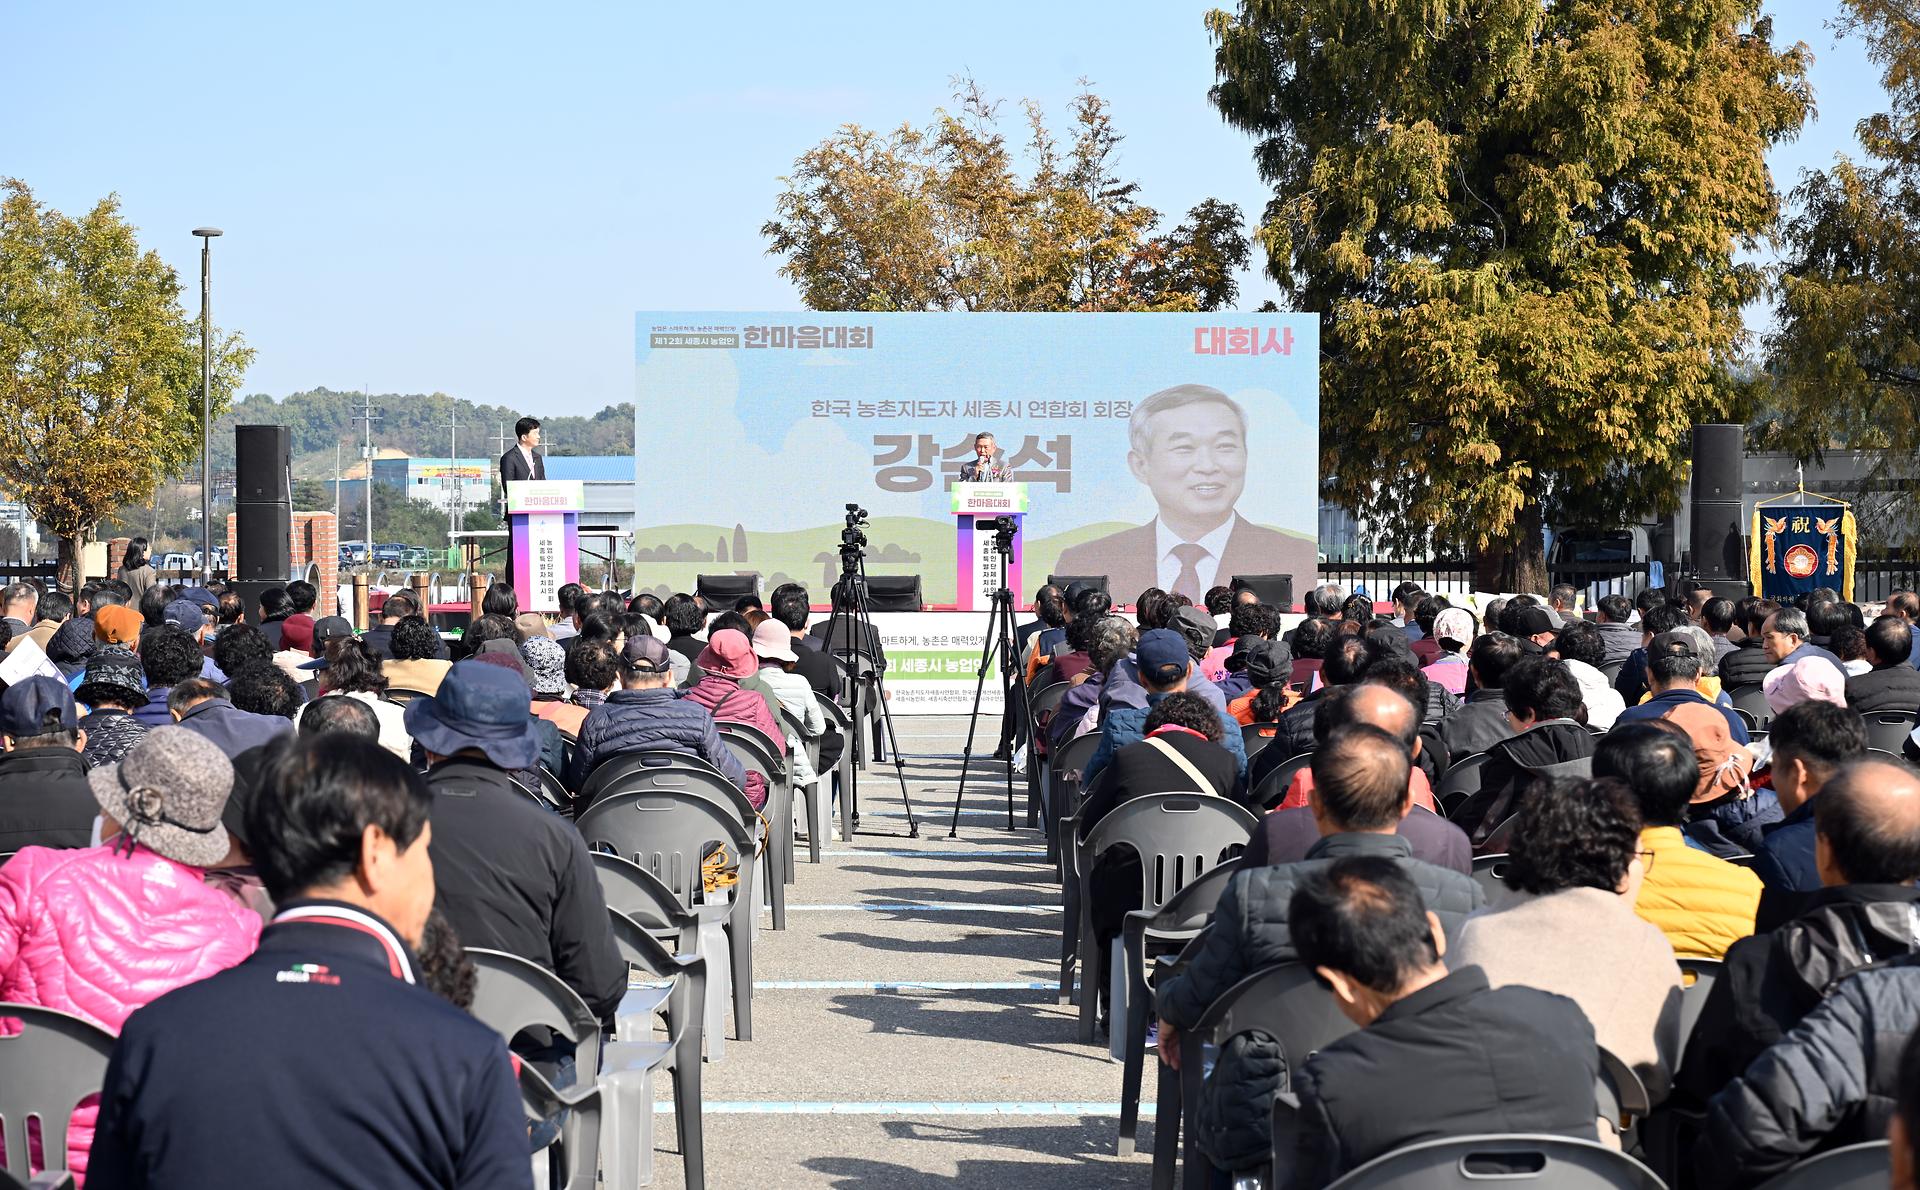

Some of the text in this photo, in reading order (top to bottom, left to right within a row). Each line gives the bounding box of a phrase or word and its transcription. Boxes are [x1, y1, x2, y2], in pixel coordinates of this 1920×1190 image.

[654, 336, 735, 346] 제12회 세종시 농업인
[743, 325, 873, 349] 한마음대회
[1194, 326, 1295, 356] 대회사
[811, 399, 1133, 419] 한국 농촌지도자 세종시 연합회 회장
[524, 496, 568, 506] 한마음대회
[967, 498, 1011, 508] 한마음대회
[1791, 516, 1811, 534] 祝
[922, 635, 949, 647] 농촌은
[900, 658, 942, 673] 세종시
